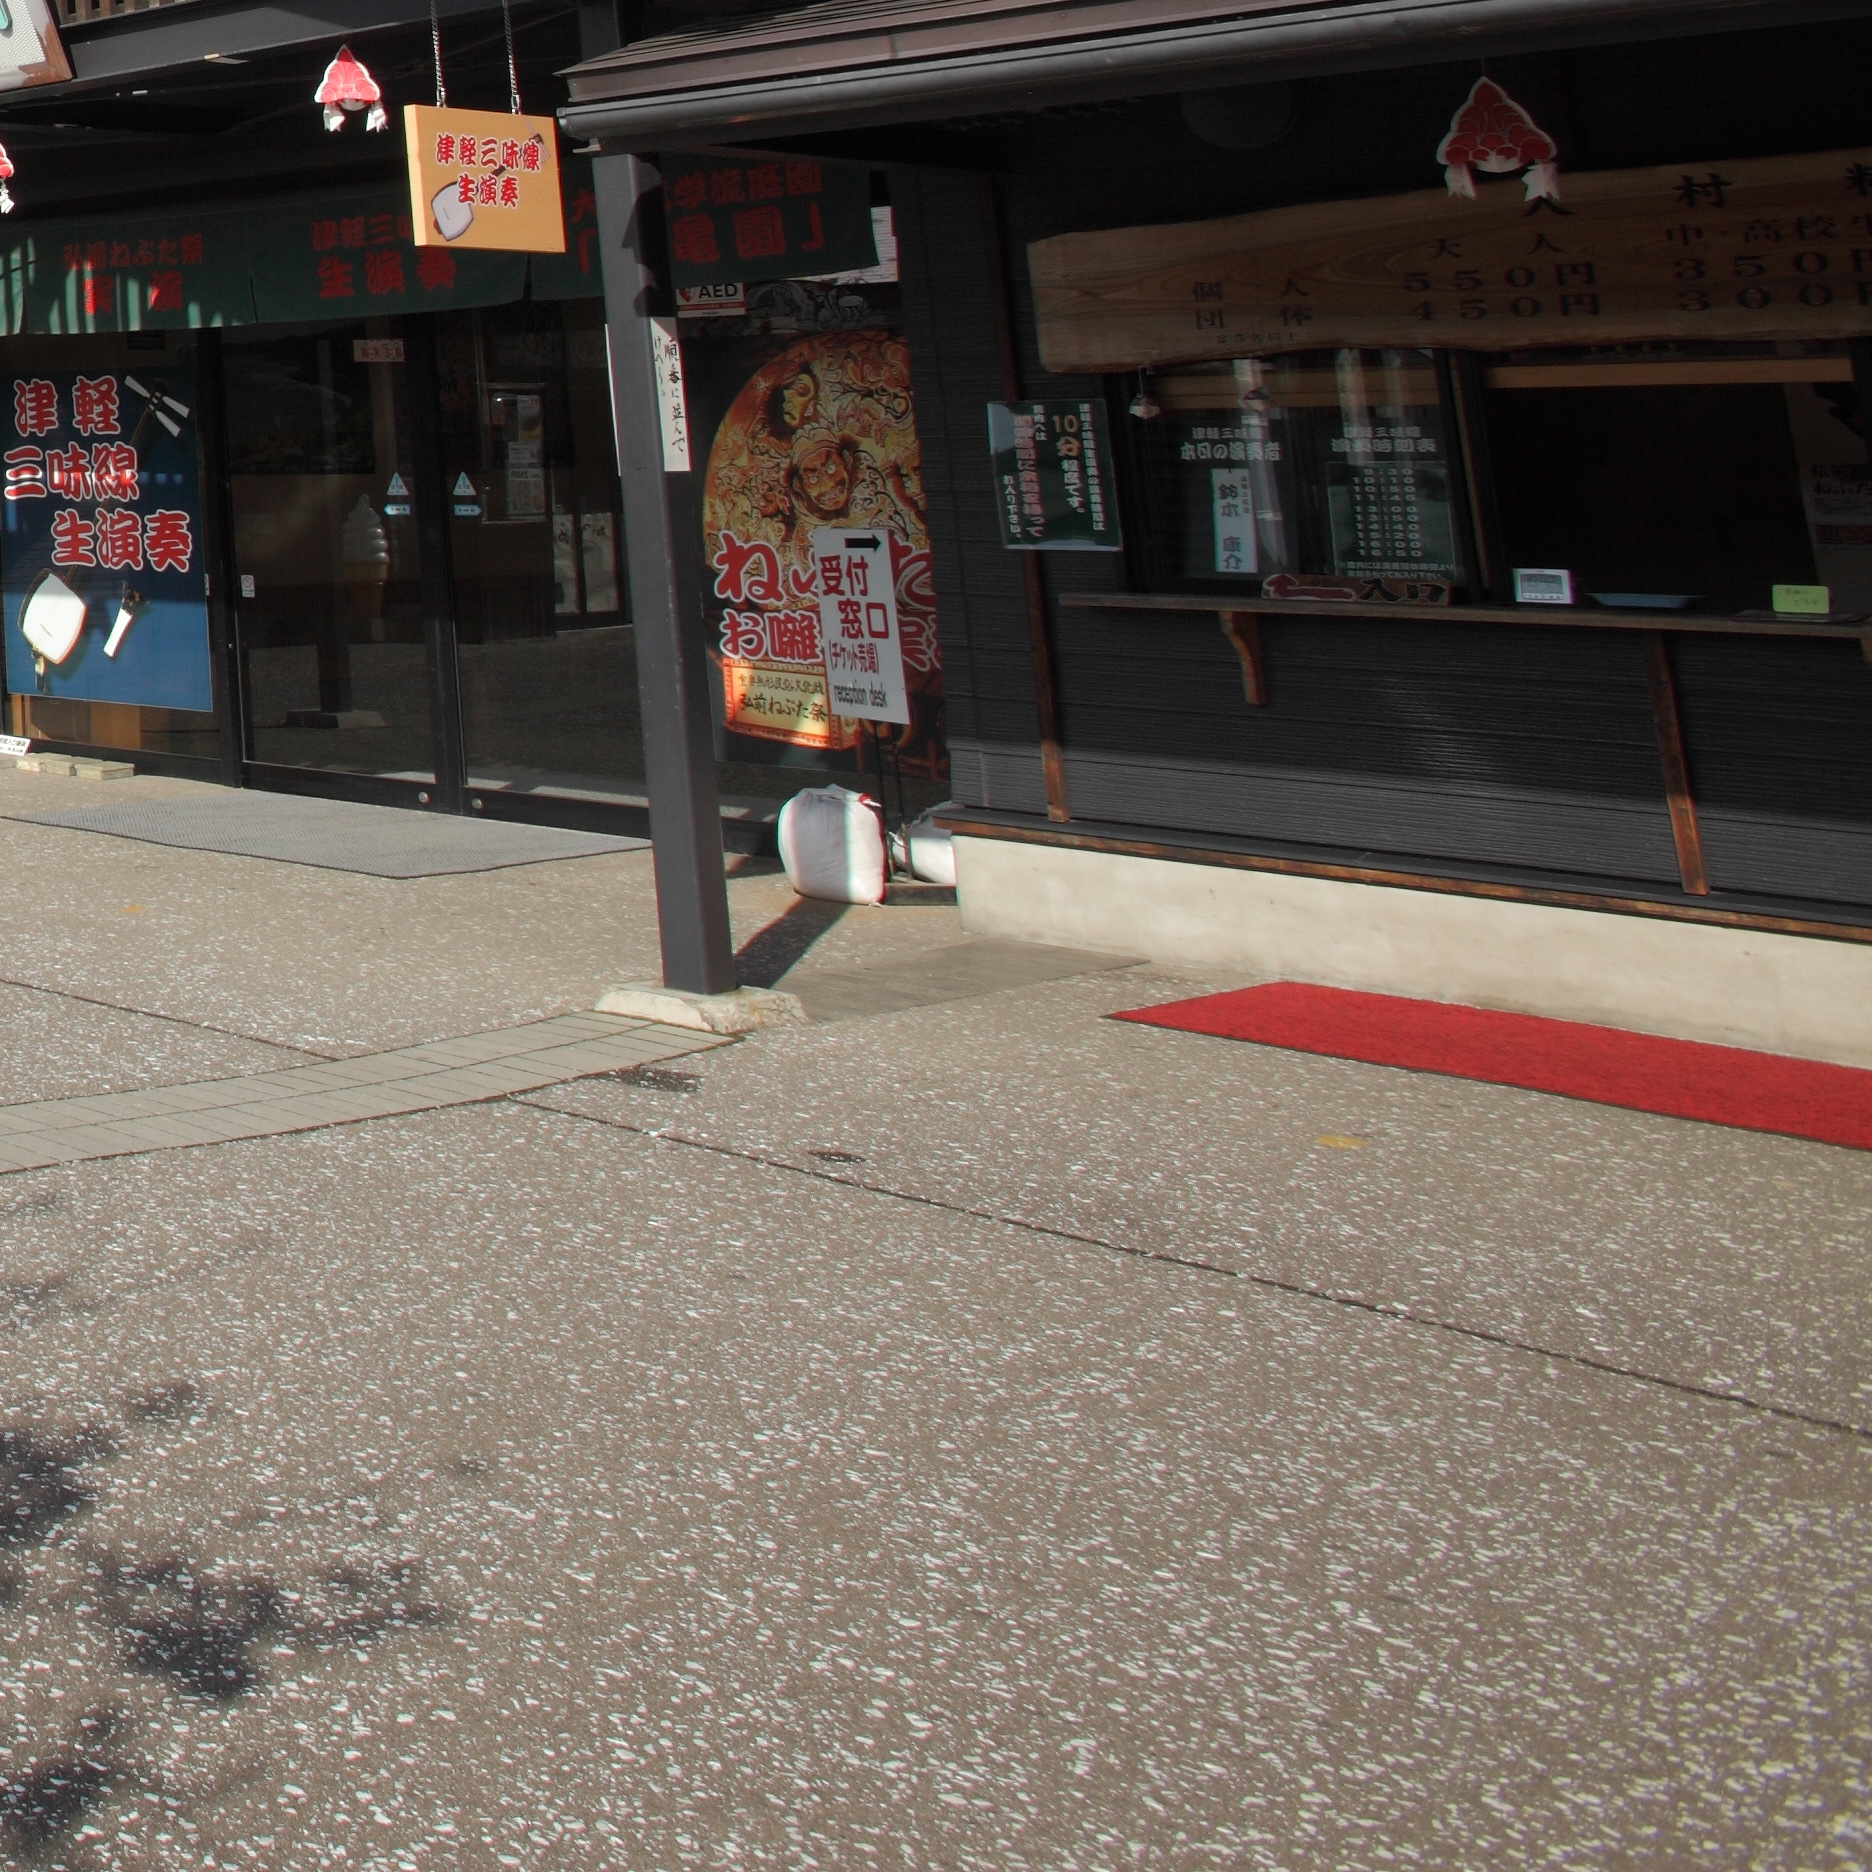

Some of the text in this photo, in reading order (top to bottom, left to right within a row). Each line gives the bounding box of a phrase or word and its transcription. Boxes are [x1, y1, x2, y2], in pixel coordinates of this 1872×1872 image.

[436, 132, 541, 172] 津軽三味線
[456, 173, 519, 208] 生演奏
[698, 283, 738, 299] AED
[14, 375, 121, 437] 津軽
[4, 442, 140, 502] 三味線
[50, 508, 194, 573] 生演奏
[819, 555, 869, 597] 受付
[838, 598, 889, 640] 窓口
[737, 691, 829, 723] 弘前ねぷた祭
[833, 679, 888, 708] reception desk
